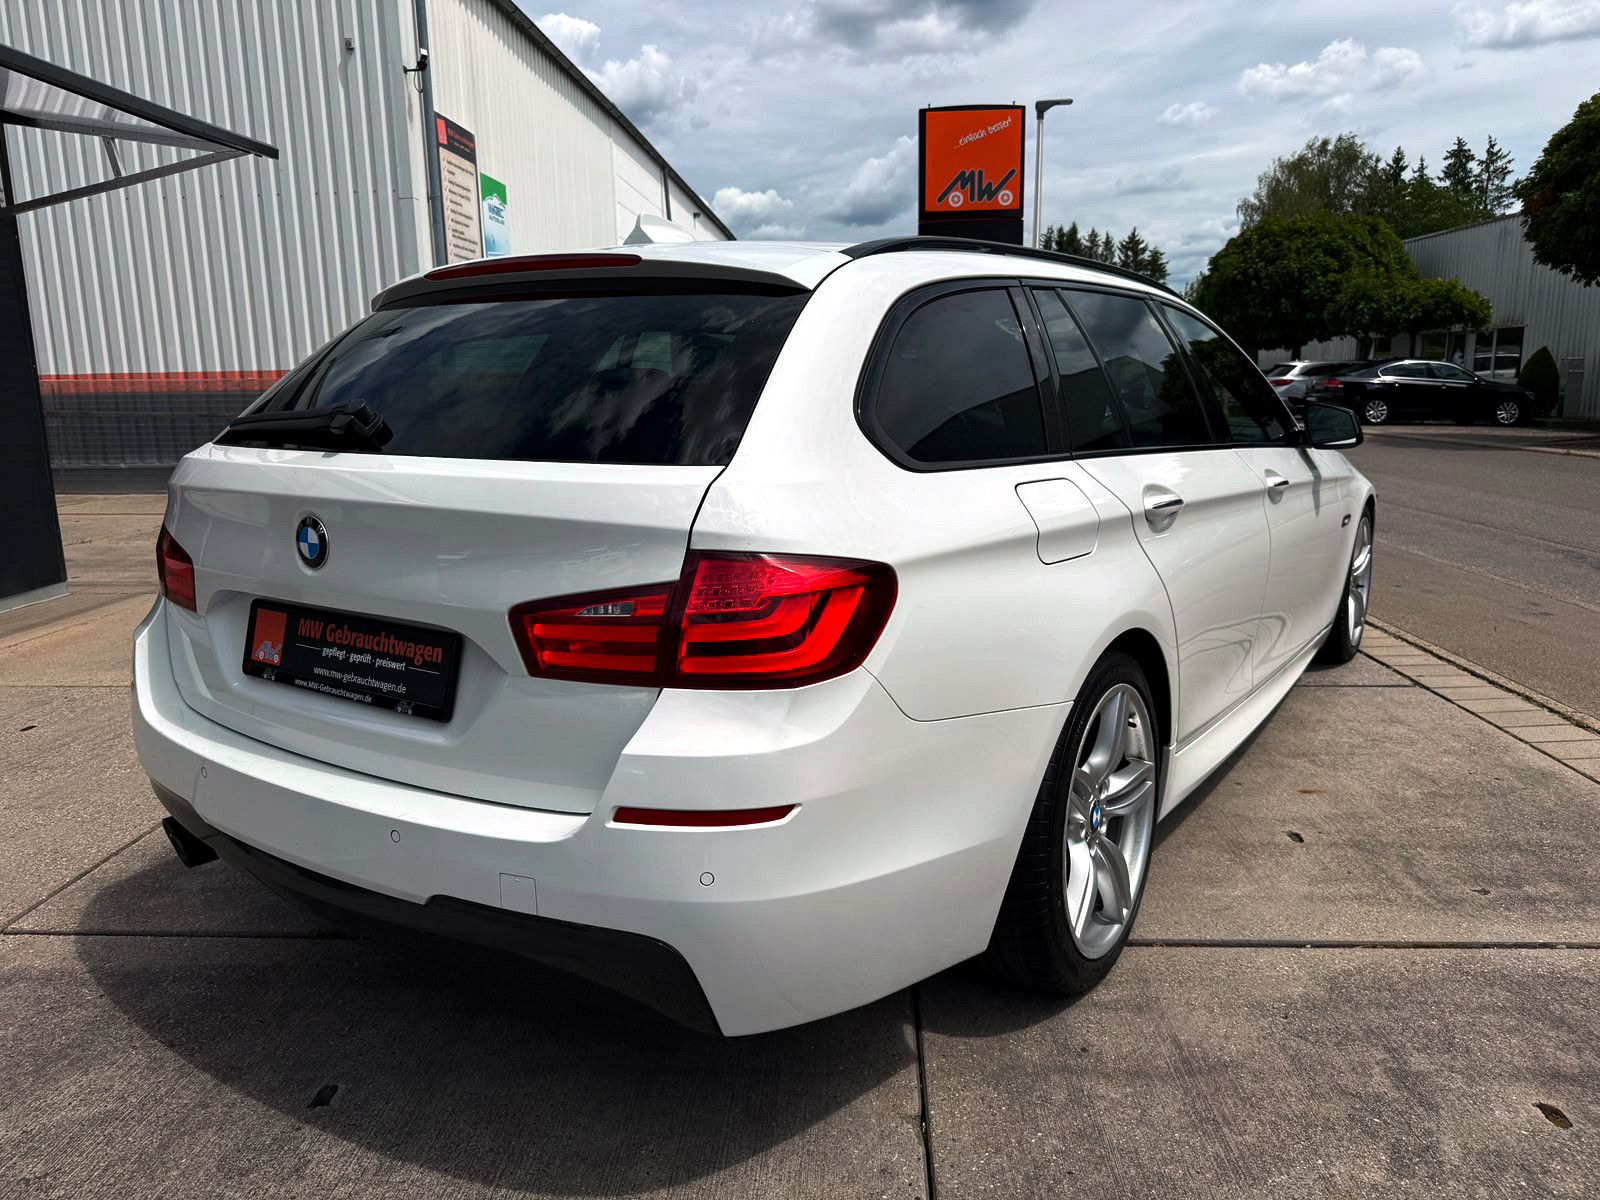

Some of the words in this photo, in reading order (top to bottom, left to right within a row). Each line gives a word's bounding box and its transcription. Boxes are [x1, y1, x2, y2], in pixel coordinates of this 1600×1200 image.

[937, 168, 1017, 204] MW
[298, 618, 324, 640] MW
[326, 624, 443, 665] Gebrauchtwagen
[322, 646, 346, 660] gepflegt
[349, 652, 372, 664] geprüft
[375, 658, 405, 671] preiswert
[294, 679, 372, 703] www.MW-Gebrauchtwagen.de
[313, 665, 407, 694] www.mw-gebrauchtwagen.de
